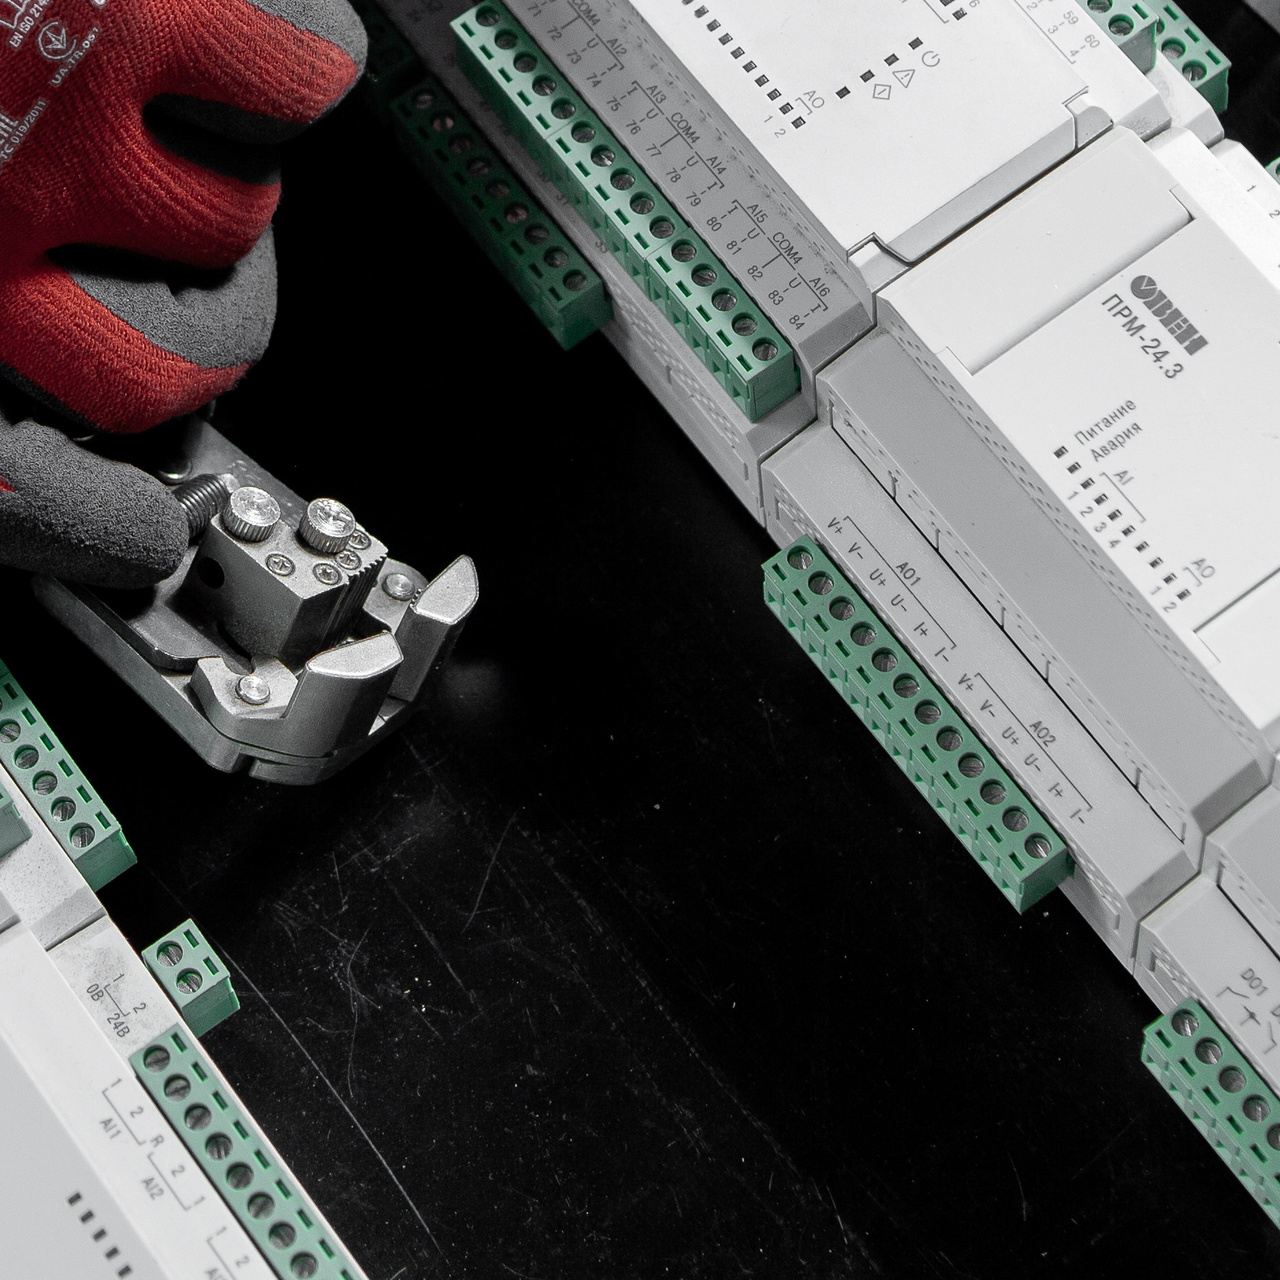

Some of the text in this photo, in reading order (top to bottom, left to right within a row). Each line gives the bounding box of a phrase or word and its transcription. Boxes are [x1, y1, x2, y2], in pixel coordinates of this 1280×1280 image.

[969, 0, 980, 8] 6
[9, 31, 20, 49] EN
[19, 14, 34, 34] ISO
[1063, 10, 1079, 25] 59
[1084, 34, 1100, 48] 60
[803, 90, 825, 109] AO
[527, 2, 542, 17] 71
[547, 26, 563, 41] 72
[566, 49, 582, 64] 73
[586, 72, 602, 88] 74
[606, 96, 622, 112] 75
[625, 119, 641, 135] 76
[646, 143, 662, 157] 77
[666, 167, 682, 183] 78
[686, 191, 702, 207] 79
[706, 216, 722, 232] 80
[726, 240, 742, 255] 81
[747, 265, 763, 281] 82
[768, 290, 784, 306] 83
[789, 314, 805, 330] 84
[606, 38, 627, 57] AI2
[646, 85, 667, 104] AI3
[671, 112, 700, 144] COM4
[706, 156, 727, 175] AI4
[747, 204, 768, 223] AI5
[772, 229, 804, 265] COM4
[809, 277, 830, 297] AI6
[1101, 293, 1184, 379] ПРМ-24.3
[1074, 400, 1136, 448] Питание
[1086, 417, 1143, 462] Авария
[1113, 470, 1134, 486] AI
[1079, 506, 1094, 518] 2
[1094, 522, 1107, 533] 3
[1191, 558, 1215, 578] AO
[1162, 601, 1177, 613] 2
[827, 517, 1085, 824] V+ V- U+ U- I+ I- V+ V- U+ U- I+ I-
[100, 1118, 121, 1139] AI1
[141, 1177, 164, 1200] AI2
